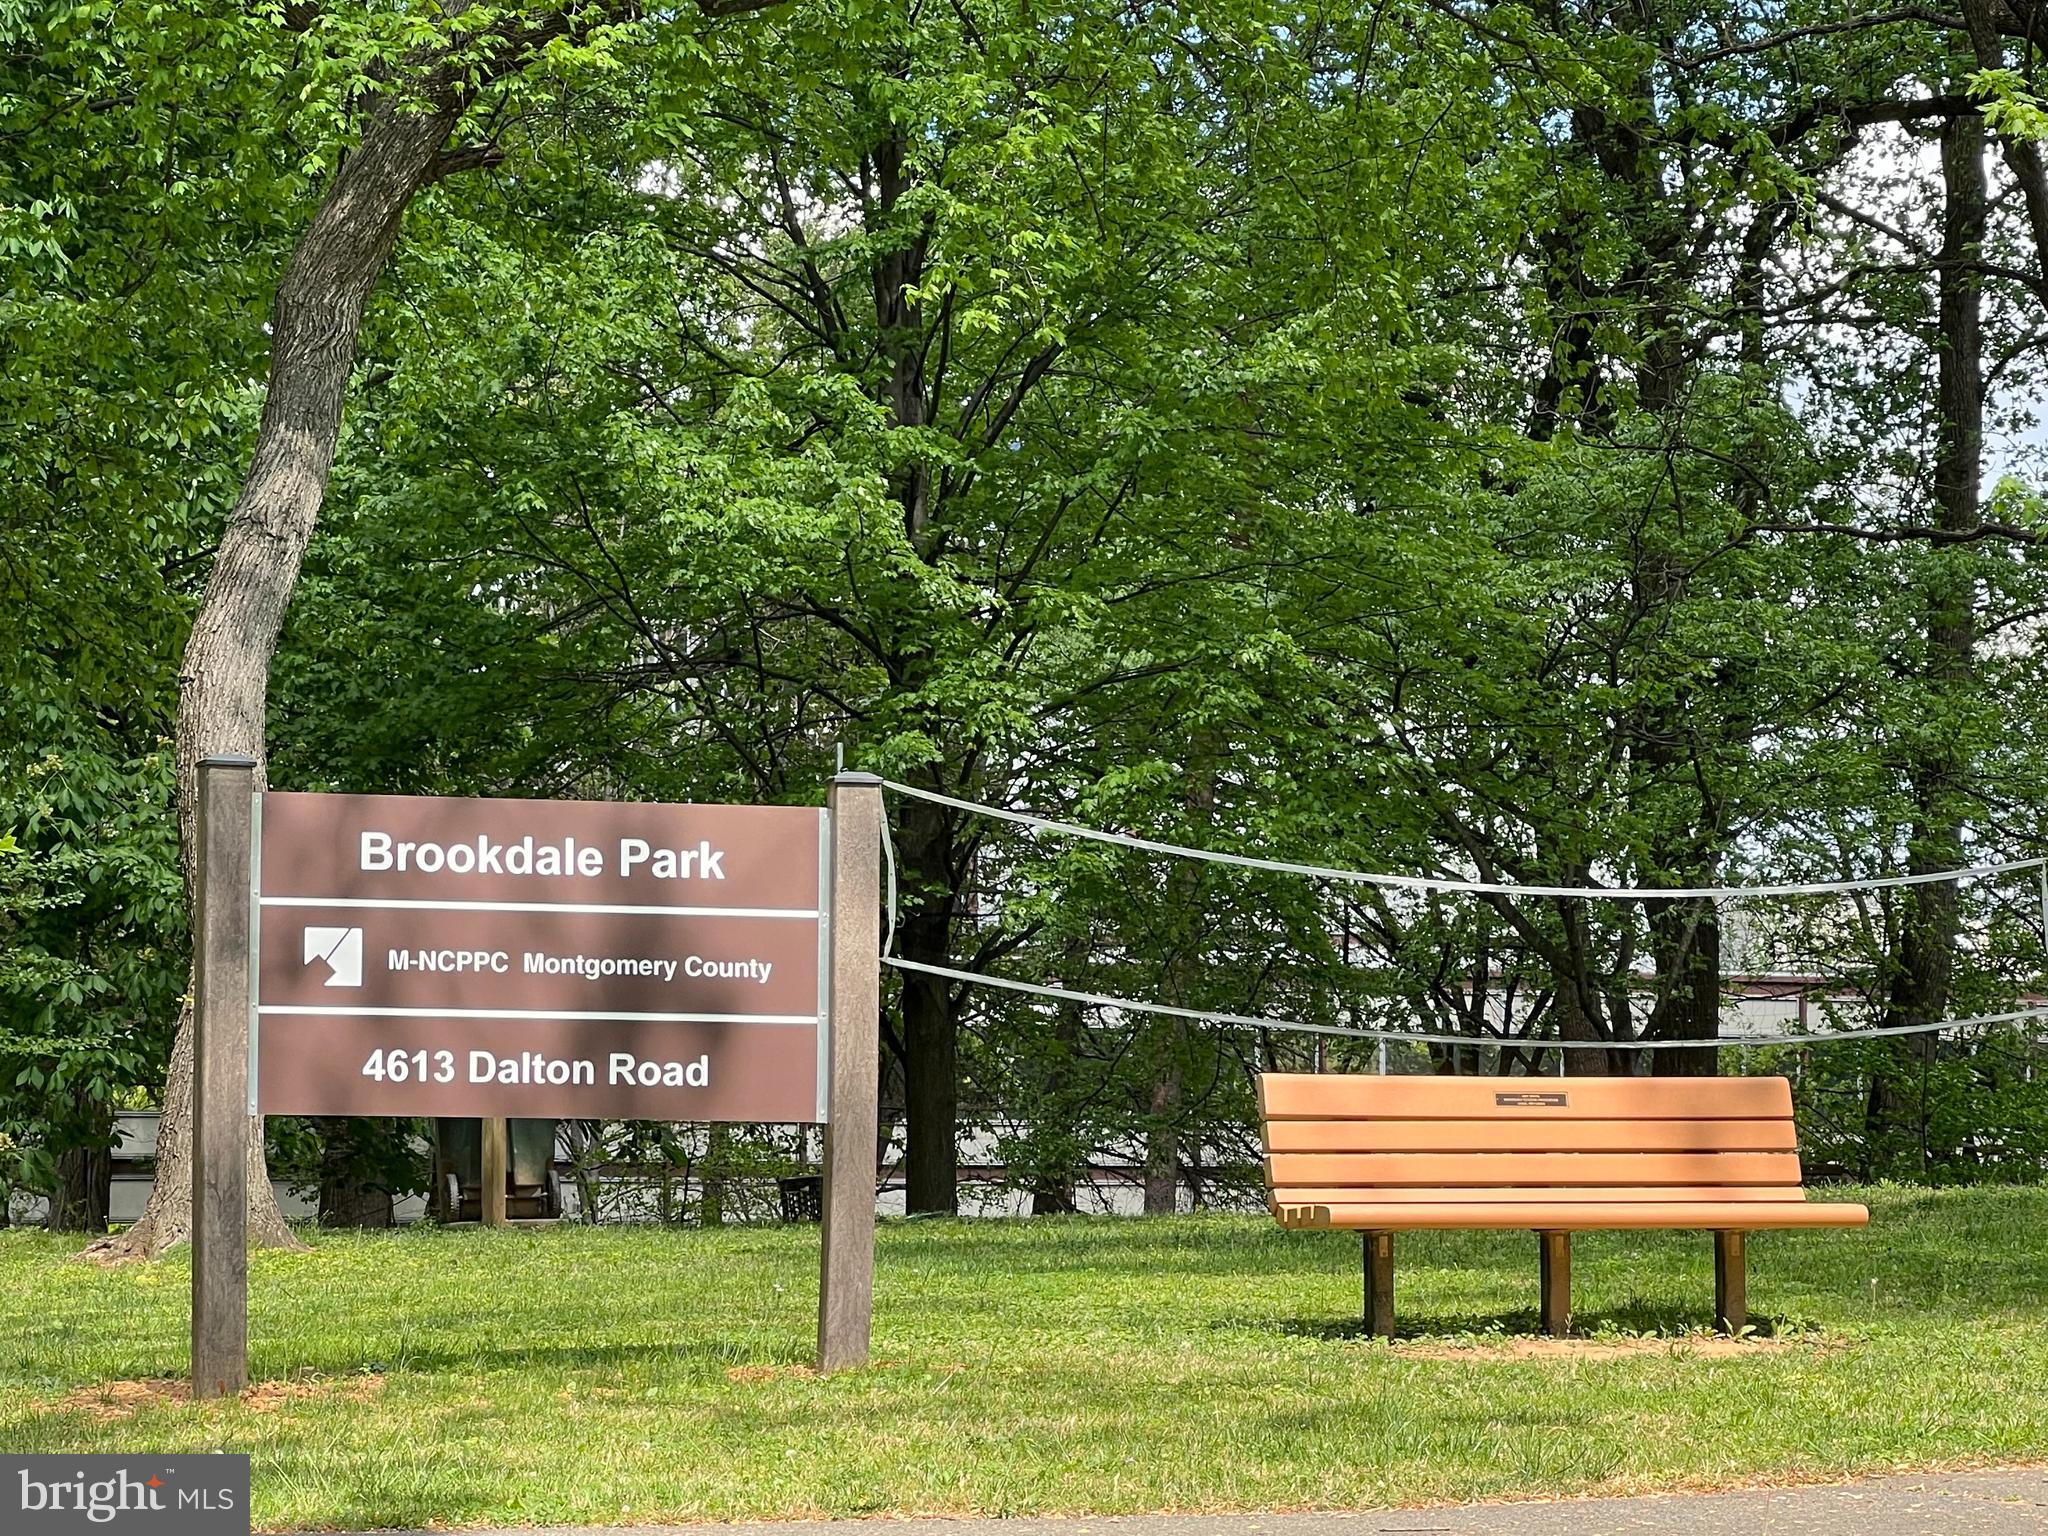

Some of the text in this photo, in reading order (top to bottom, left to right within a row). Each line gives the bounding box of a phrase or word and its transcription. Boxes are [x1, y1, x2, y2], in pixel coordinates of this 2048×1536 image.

[360, 831, 726, 880] Brookdale Park
[388, 949, 773, 984] M-NCPPC Montgomery County
[362, 1048, 709, 1087] 4613 Dalton Road
